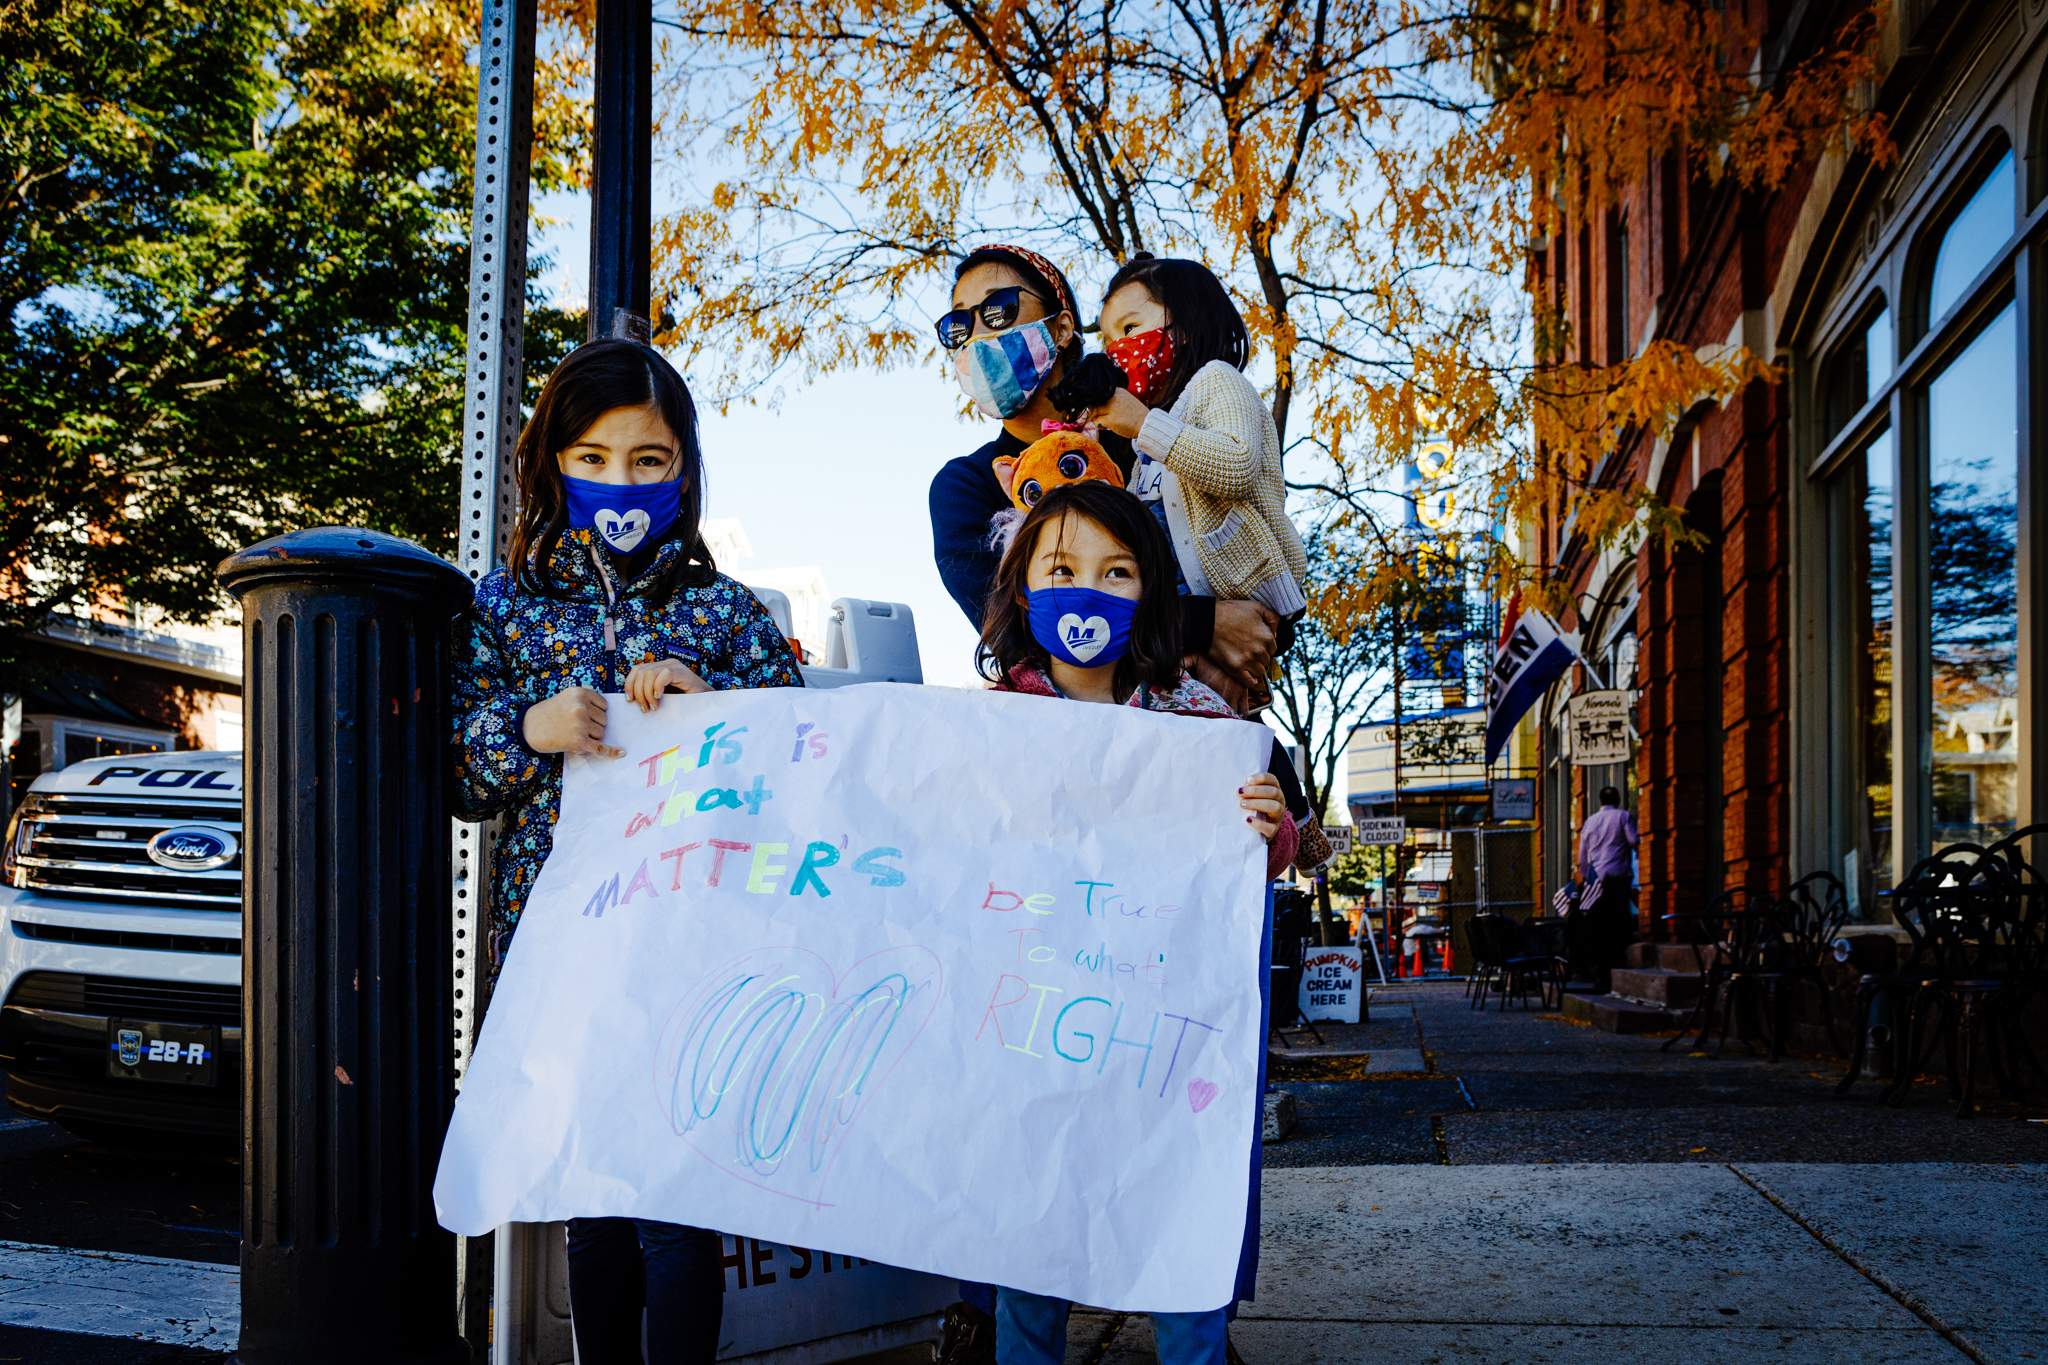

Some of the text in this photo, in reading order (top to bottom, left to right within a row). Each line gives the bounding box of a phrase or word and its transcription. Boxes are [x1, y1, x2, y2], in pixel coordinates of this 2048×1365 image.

[668, 649, 697, 662] patagonia
[638, 721, 830, 788] This is
[87, 766, 242, 791] POL
[1323, 829, 1349, 839] WALK
[1361, 820, 1403, 831] SIDEWALK
[1365, 831, 1400, 842] CLOSED
[166, 836, 211, 858] Ford
[582, 833, 907, 918] MATTER'S
[1075, 880, 1184, 921] True
[1007, 927, 1057, 963] To
[1304, 953, 1362, 973] PUMPKIN
[1318, 967, 1342, 978] ICE
[1307, 979, 1352, 991] CREAM
[1310, 994, 1346, 1006] HERE
[975, 974, 1223, 1098] RIGHT
[148, 1040, 205, 1065] 28-R
[717, 1234, 776, 1293] HE
